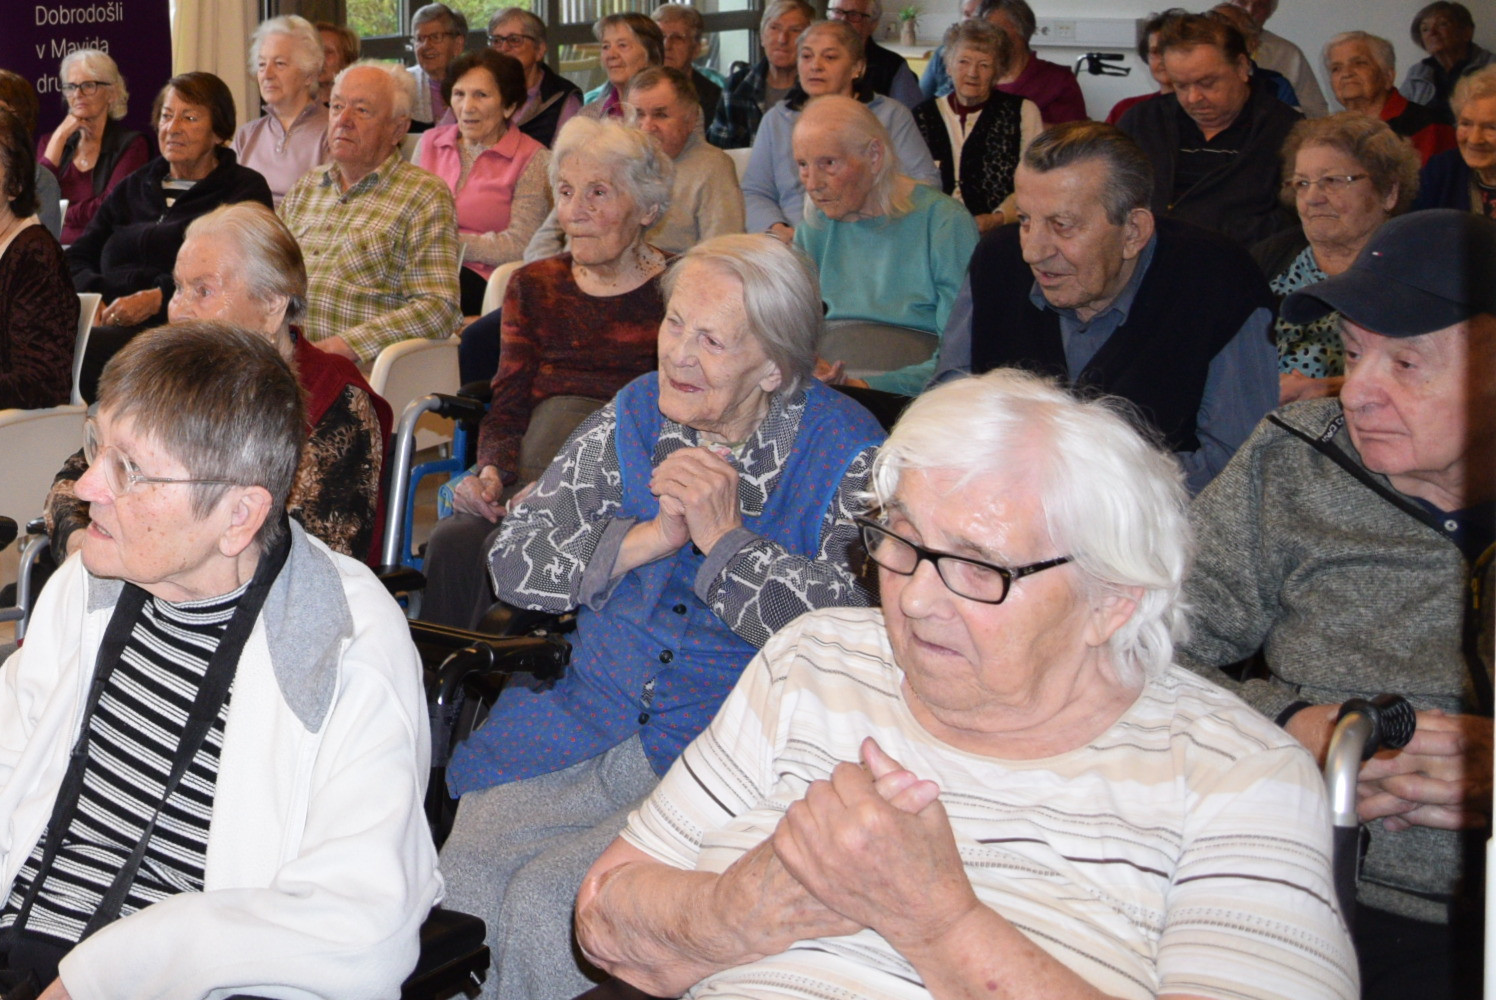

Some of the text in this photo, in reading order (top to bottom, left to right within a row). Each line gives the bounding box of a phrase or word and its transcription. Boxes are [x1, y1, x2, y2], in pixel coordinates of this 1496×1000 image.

[35, 1, 123, 26] Dobrodošli
[35, 43, 45, 59] v
[36, 73, 62, 94] dru
